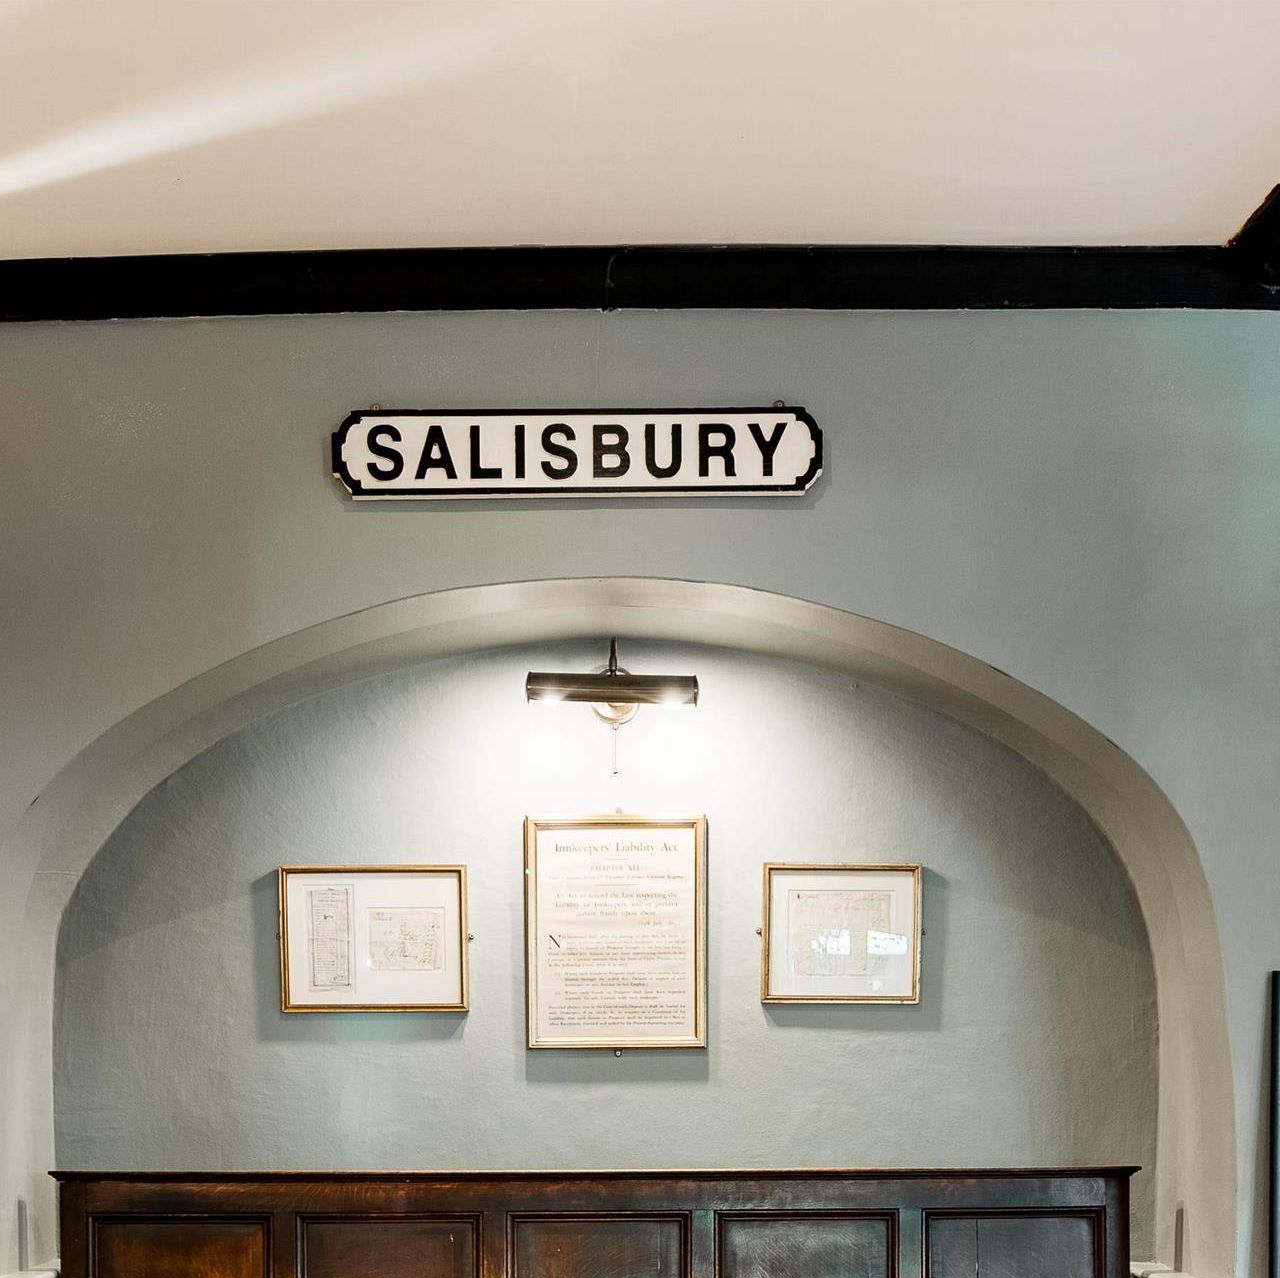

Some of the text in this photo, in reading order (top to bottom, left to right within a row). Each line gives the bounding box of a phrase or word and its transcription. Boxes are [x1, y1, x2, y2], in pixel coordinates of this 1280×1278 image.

[366, 422, 788, 481] SALISBURY
[615, 842, 655, 856] Liability
[662, 842, 678, 852] Act
